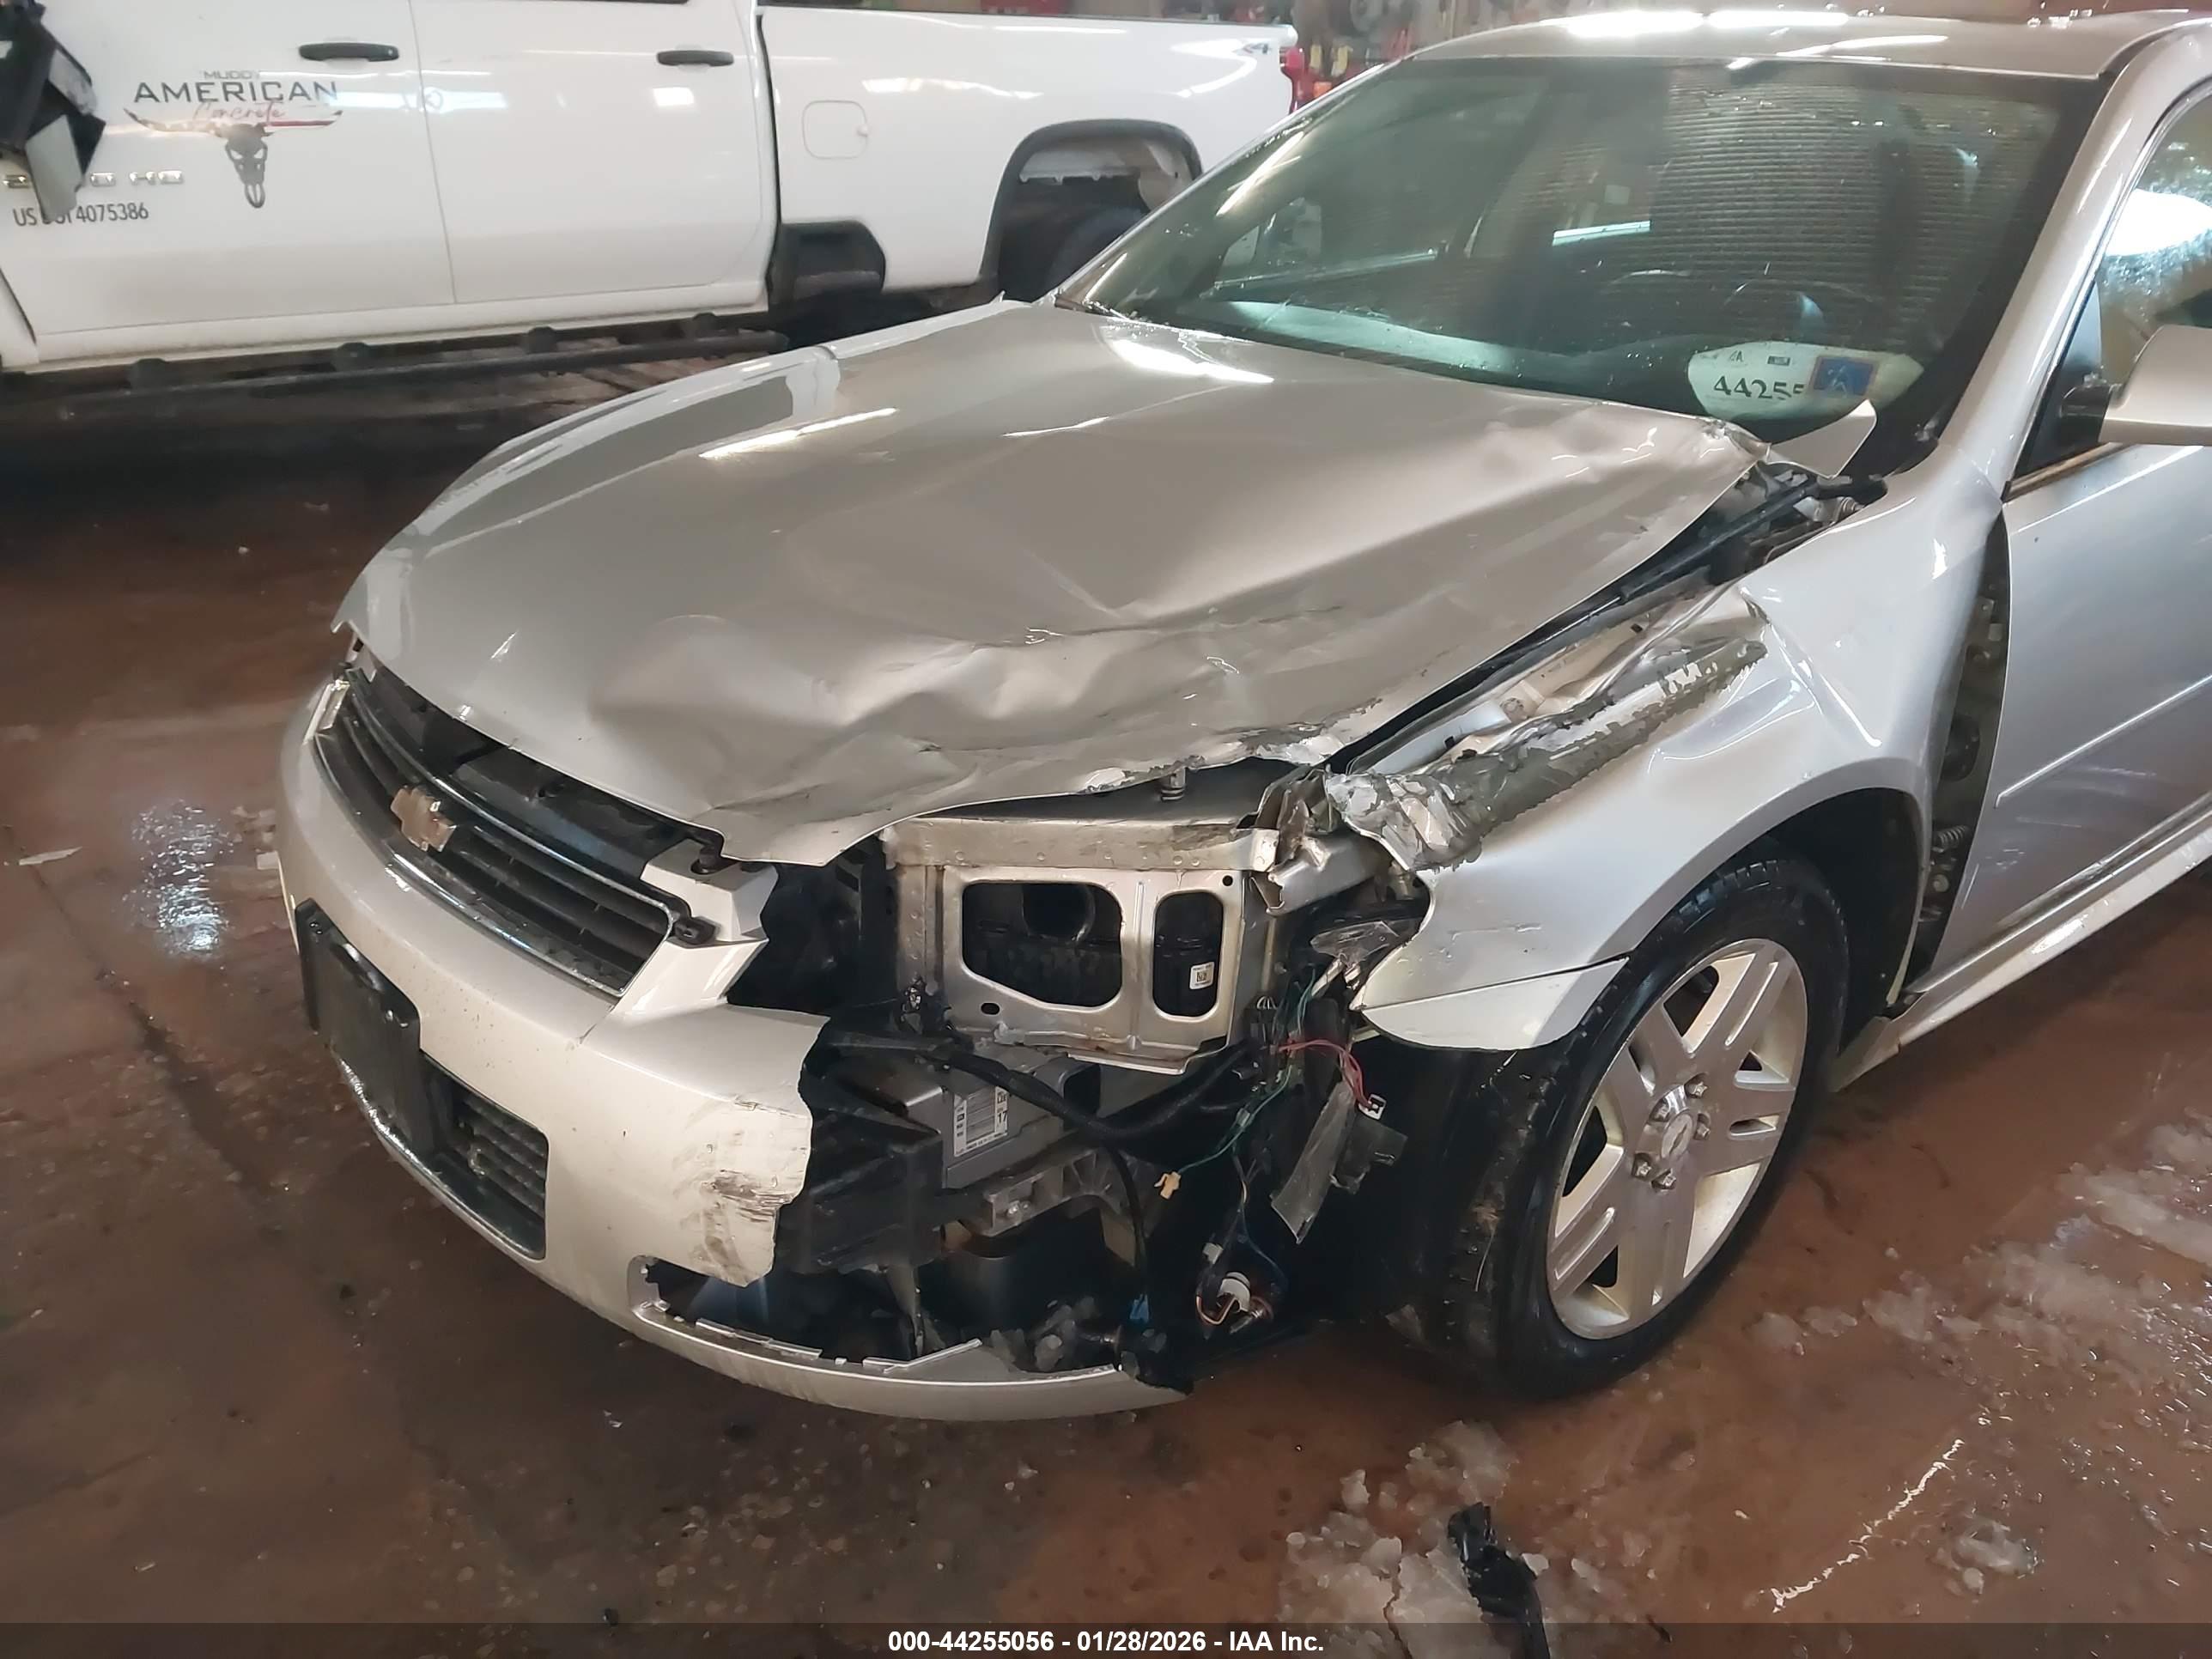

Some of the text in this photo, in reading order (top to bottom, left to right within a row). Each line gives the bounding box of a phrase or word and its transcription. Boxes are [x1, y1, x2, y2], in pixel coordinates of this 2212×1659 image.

[133, 81, 338, 103] AMERICAN
[13, 207, 38, 227] US
[76, 202, 149, 223] 4075386
